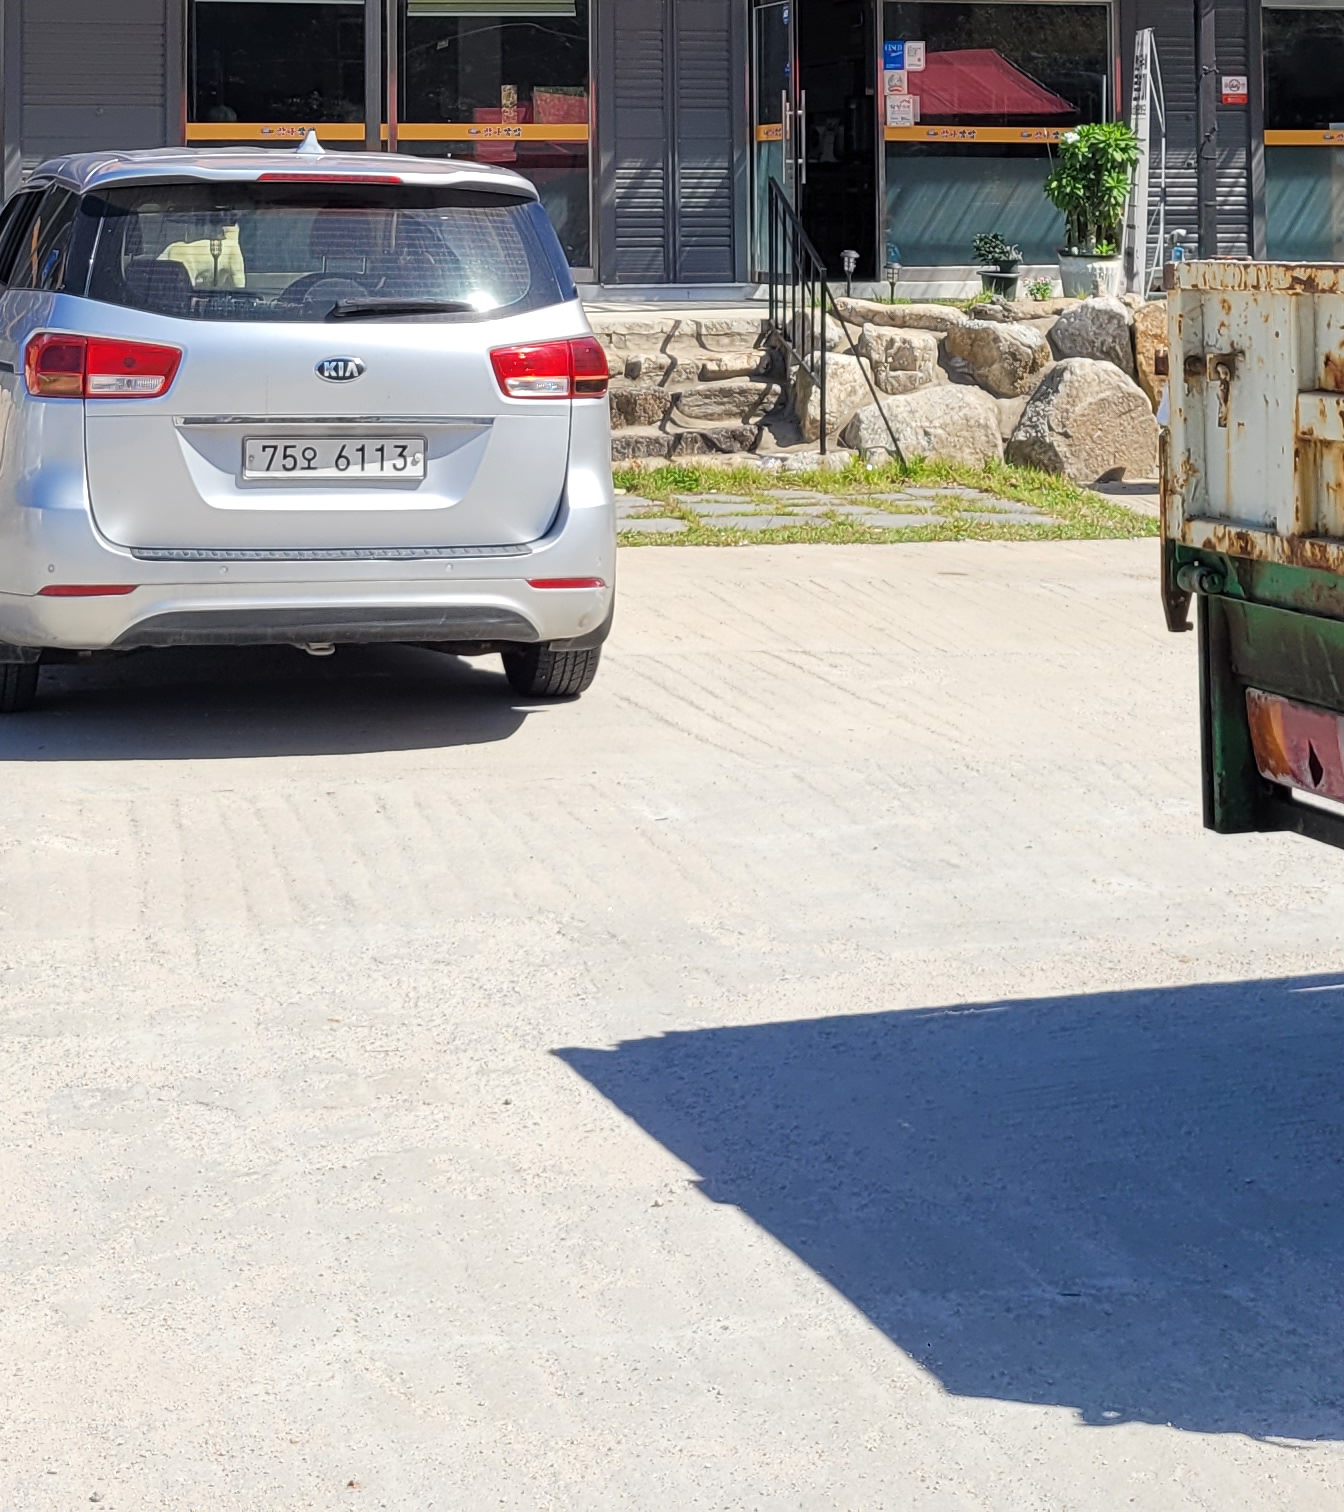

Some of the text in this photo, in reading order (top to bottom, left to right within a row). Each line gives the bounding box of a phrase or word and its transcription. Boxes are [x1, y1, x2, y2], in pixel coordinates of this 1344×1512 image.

[323, 361, 359, 377] KIA
[261, 443, 408, 472] 75오 6113
